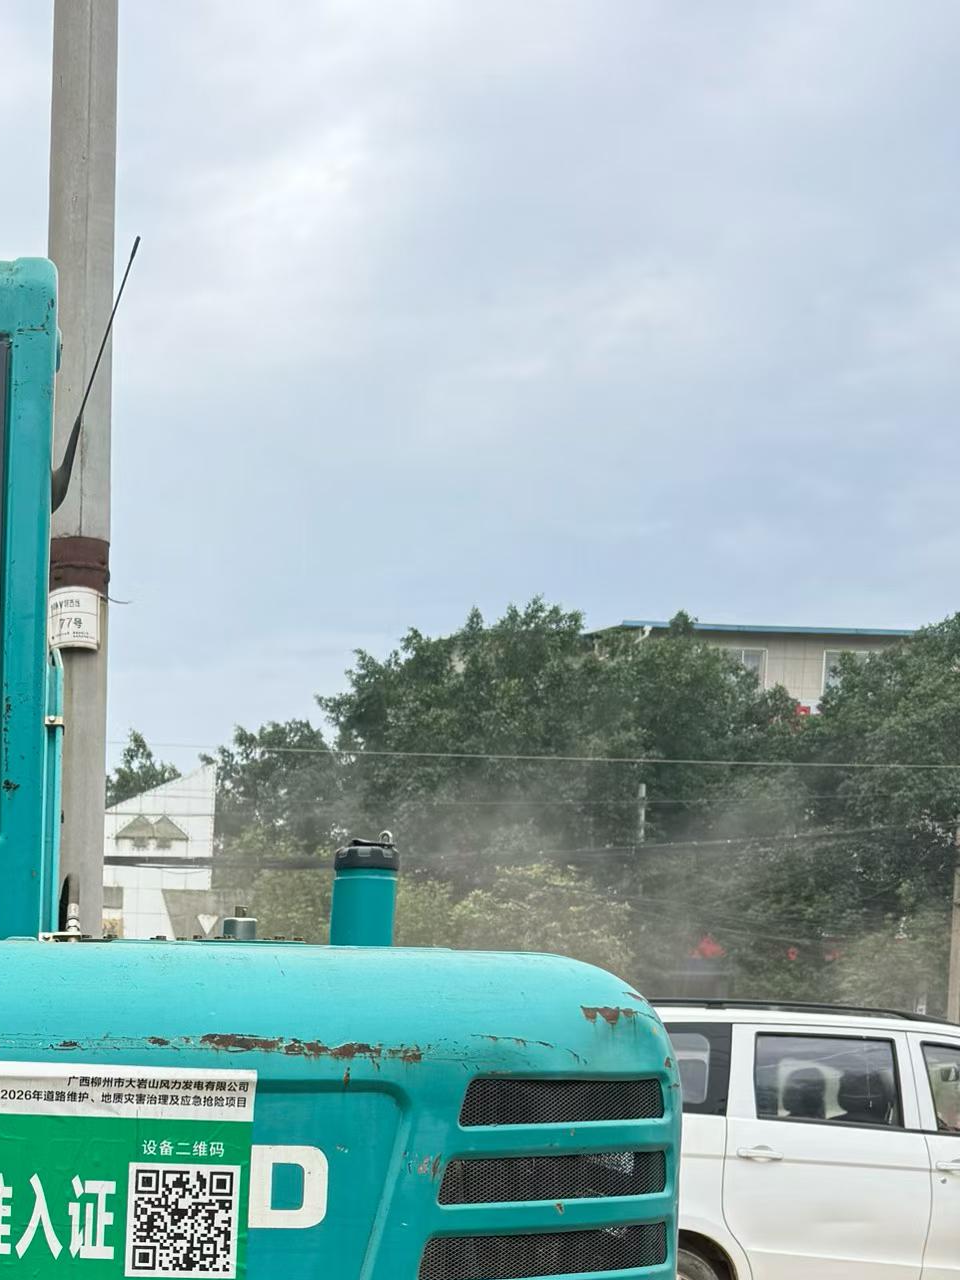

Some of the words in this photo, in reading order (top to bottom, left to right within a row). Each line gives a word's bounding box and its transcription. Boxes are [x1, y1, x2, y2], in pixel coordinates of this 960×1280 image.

[67, 1076, 249, 1093] 广西柳州市大岩山风力发电有限公司
[142, 1140, 225, 1157] 设备二维码
